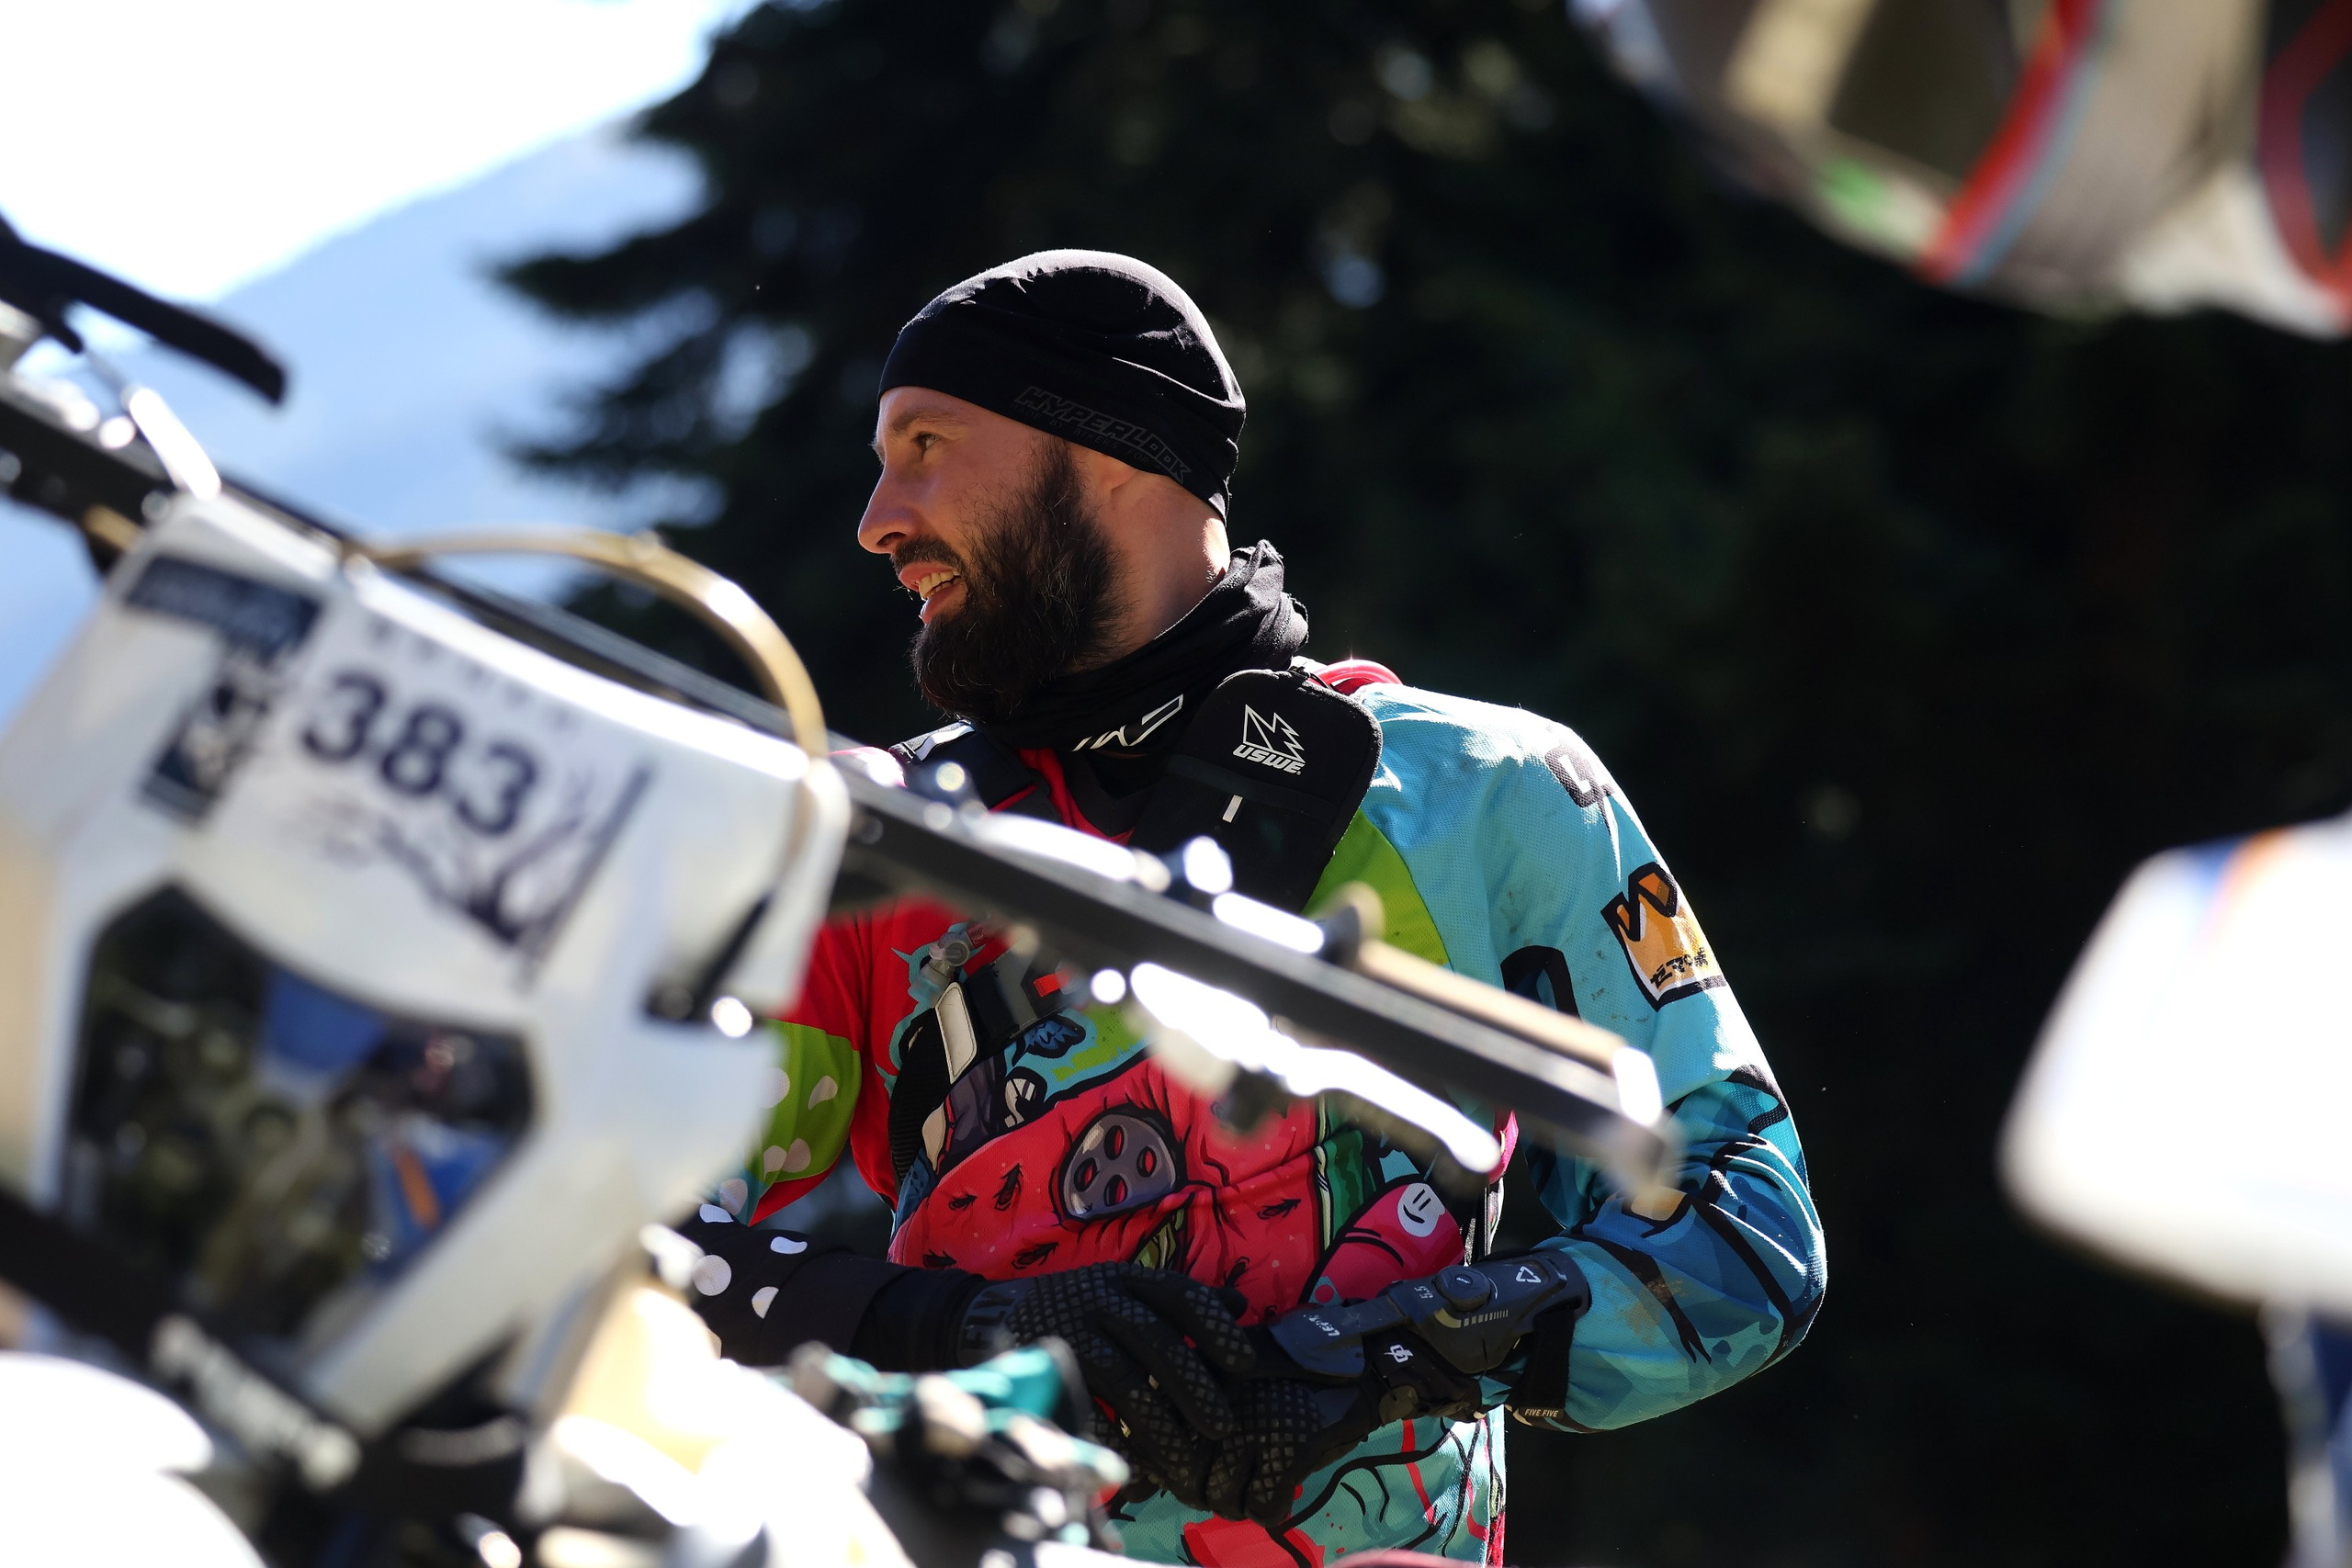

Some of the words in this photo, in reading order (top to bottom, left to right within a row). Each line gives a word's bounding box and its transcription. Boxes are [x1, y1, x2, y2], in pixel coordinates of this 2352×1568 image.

[1013, 385, 1192, 485] HYPERLOOK
[1049, 419, 1063, 429] BY
[1073, 428, 1117, 448] BIKERS
[1126, 447, 1148, 463] FOR
[300, 670, 540, 837] 383
[1232, 744, 1306, 774] USWE
